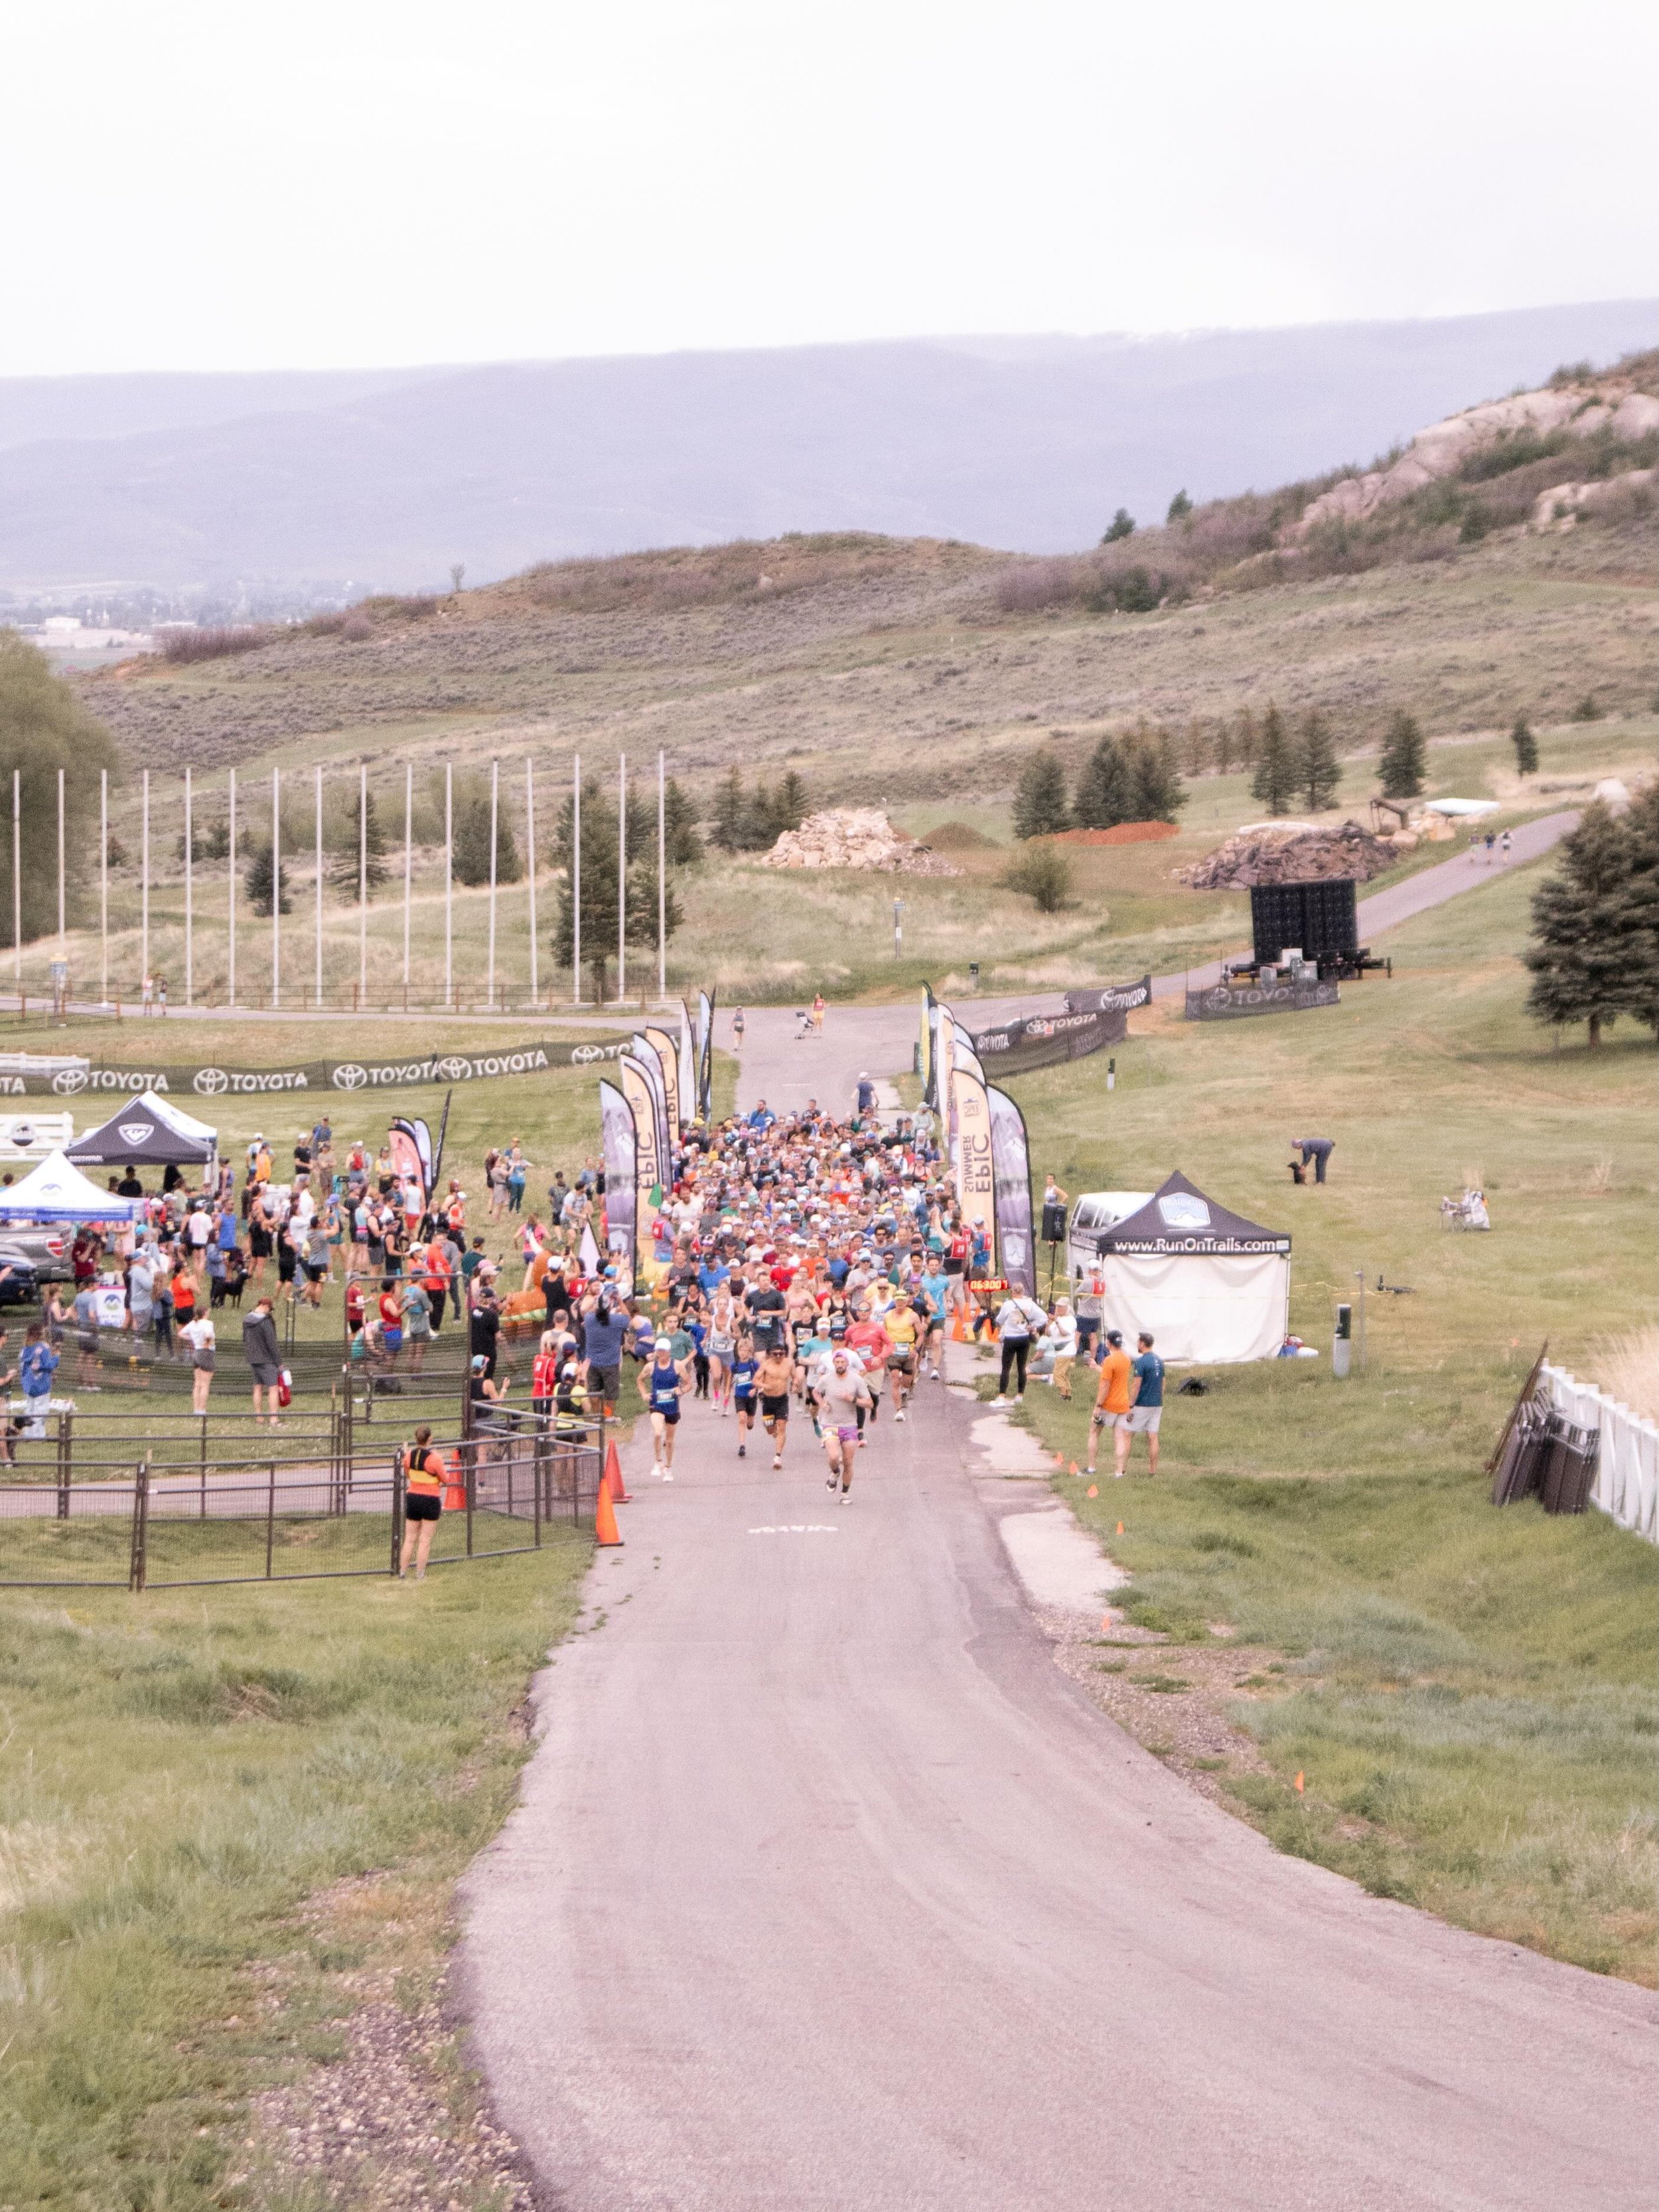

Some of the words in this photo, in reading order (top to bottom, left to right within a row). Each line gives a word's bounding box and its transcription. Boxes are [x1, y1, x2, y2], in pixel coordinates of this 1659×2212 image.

[1050, 1013, 1096, 1029] TOYOTA
[474, 1050, 548, 1076] TOYOTA
[90, 1070, 169, 1090] TOYOTA
[231, 1072, 308, 1091] TOYOTA
[1116, 1238, 1276, 1251] www.RunOnTrails.com
